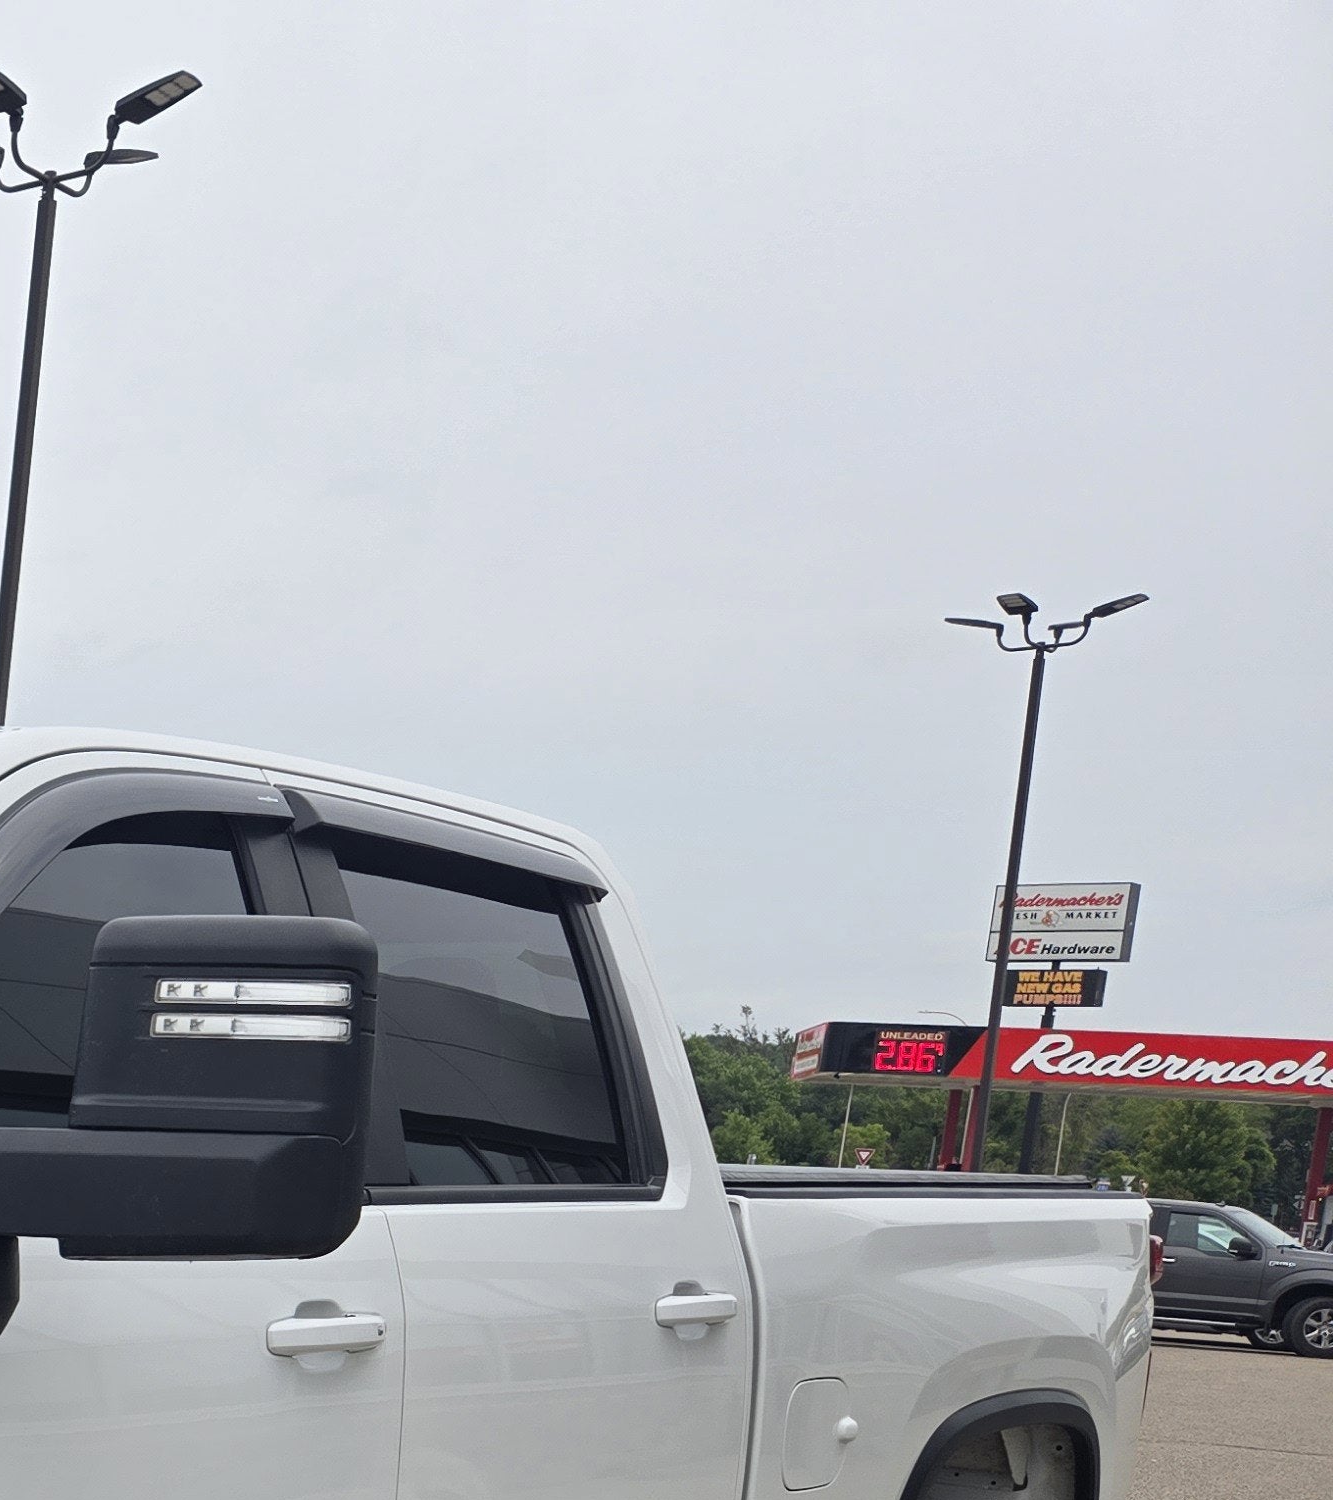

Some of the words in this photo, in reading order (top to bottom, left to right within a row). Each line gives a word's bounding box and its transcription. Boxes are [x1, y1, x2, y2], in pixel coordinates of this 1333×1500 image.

[999, 892, 1125, 908] adermacher's
[1064, 911, 1118, 919] MARKET
[1040, 944, 1115, 955] Hardware
[1018, 971, 1040, 982] WE
[1043, 971, 1083, 982] HAVE
[1016, 983, 1050, 993] NEW
[1052, 983, 1082, 993] GAS
[881, 1031, 943, 1041] UNLEADED
